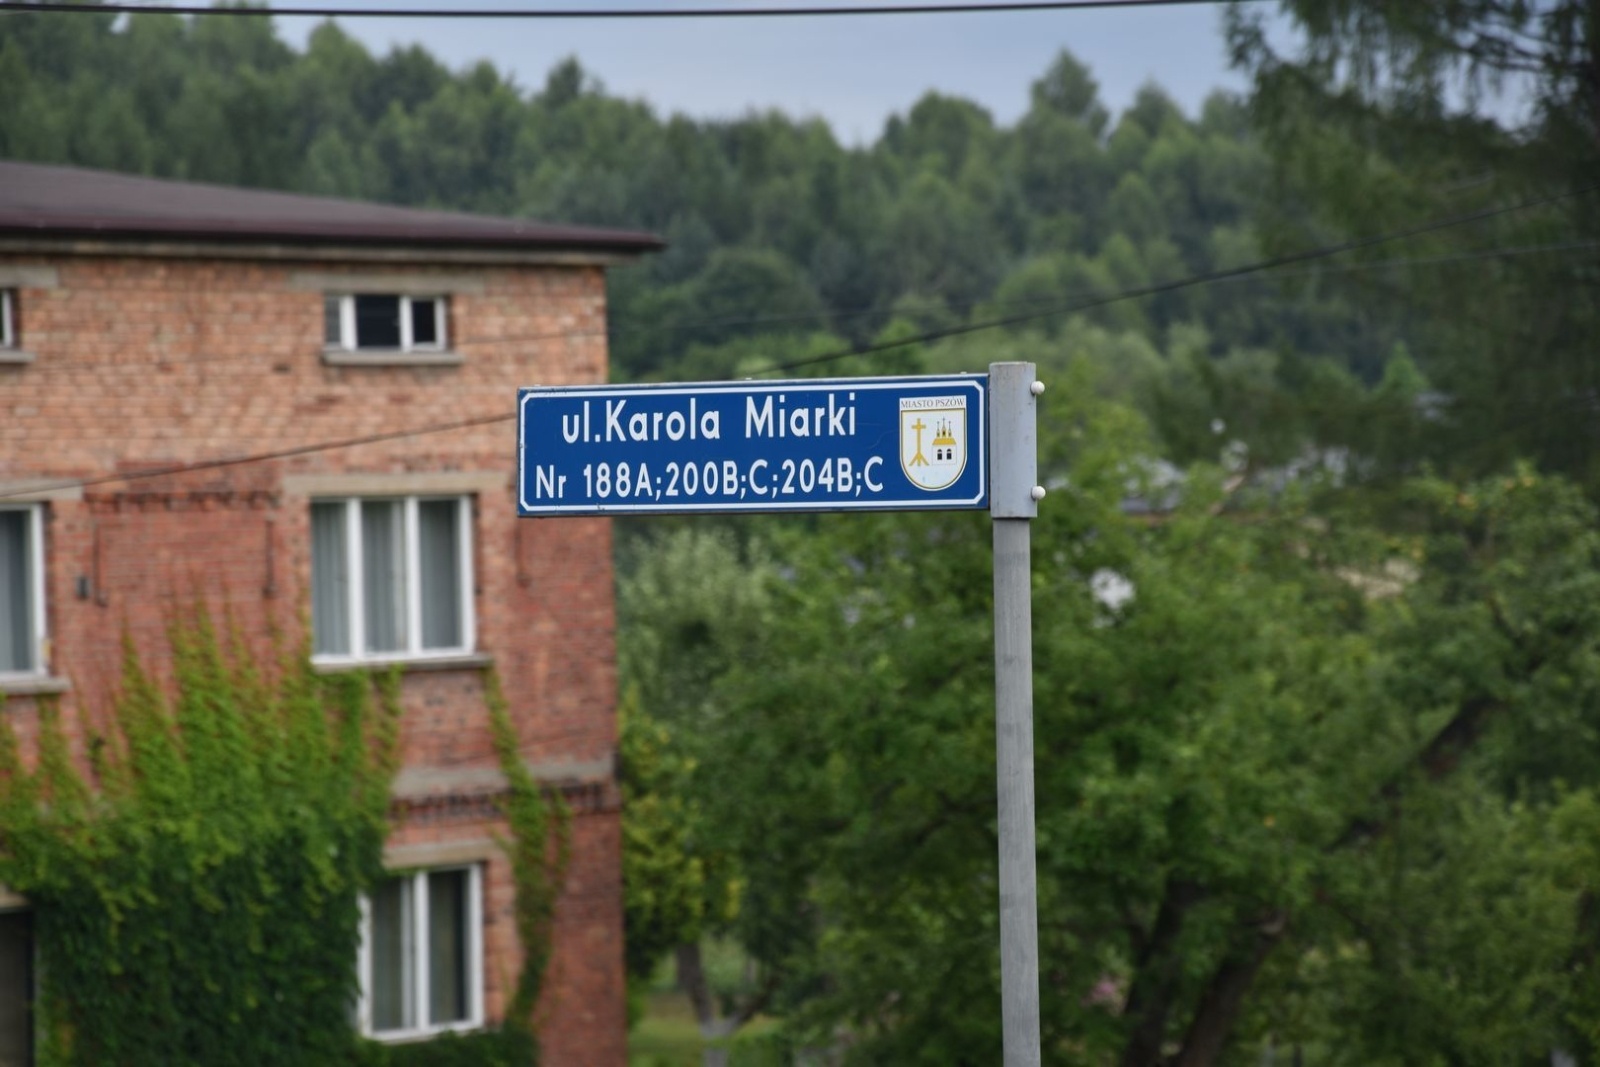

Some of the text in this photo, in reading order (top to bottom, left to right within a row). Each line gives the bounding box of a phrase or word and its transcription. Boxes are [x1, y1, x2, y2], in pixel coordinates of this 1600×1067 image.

[745, 392, 855, 438] Miarki
[901, 396, 965, 408] MIASTO PSZÓW
[536, 456, 884, 501] Nr 188A;200B;C;204B;C
